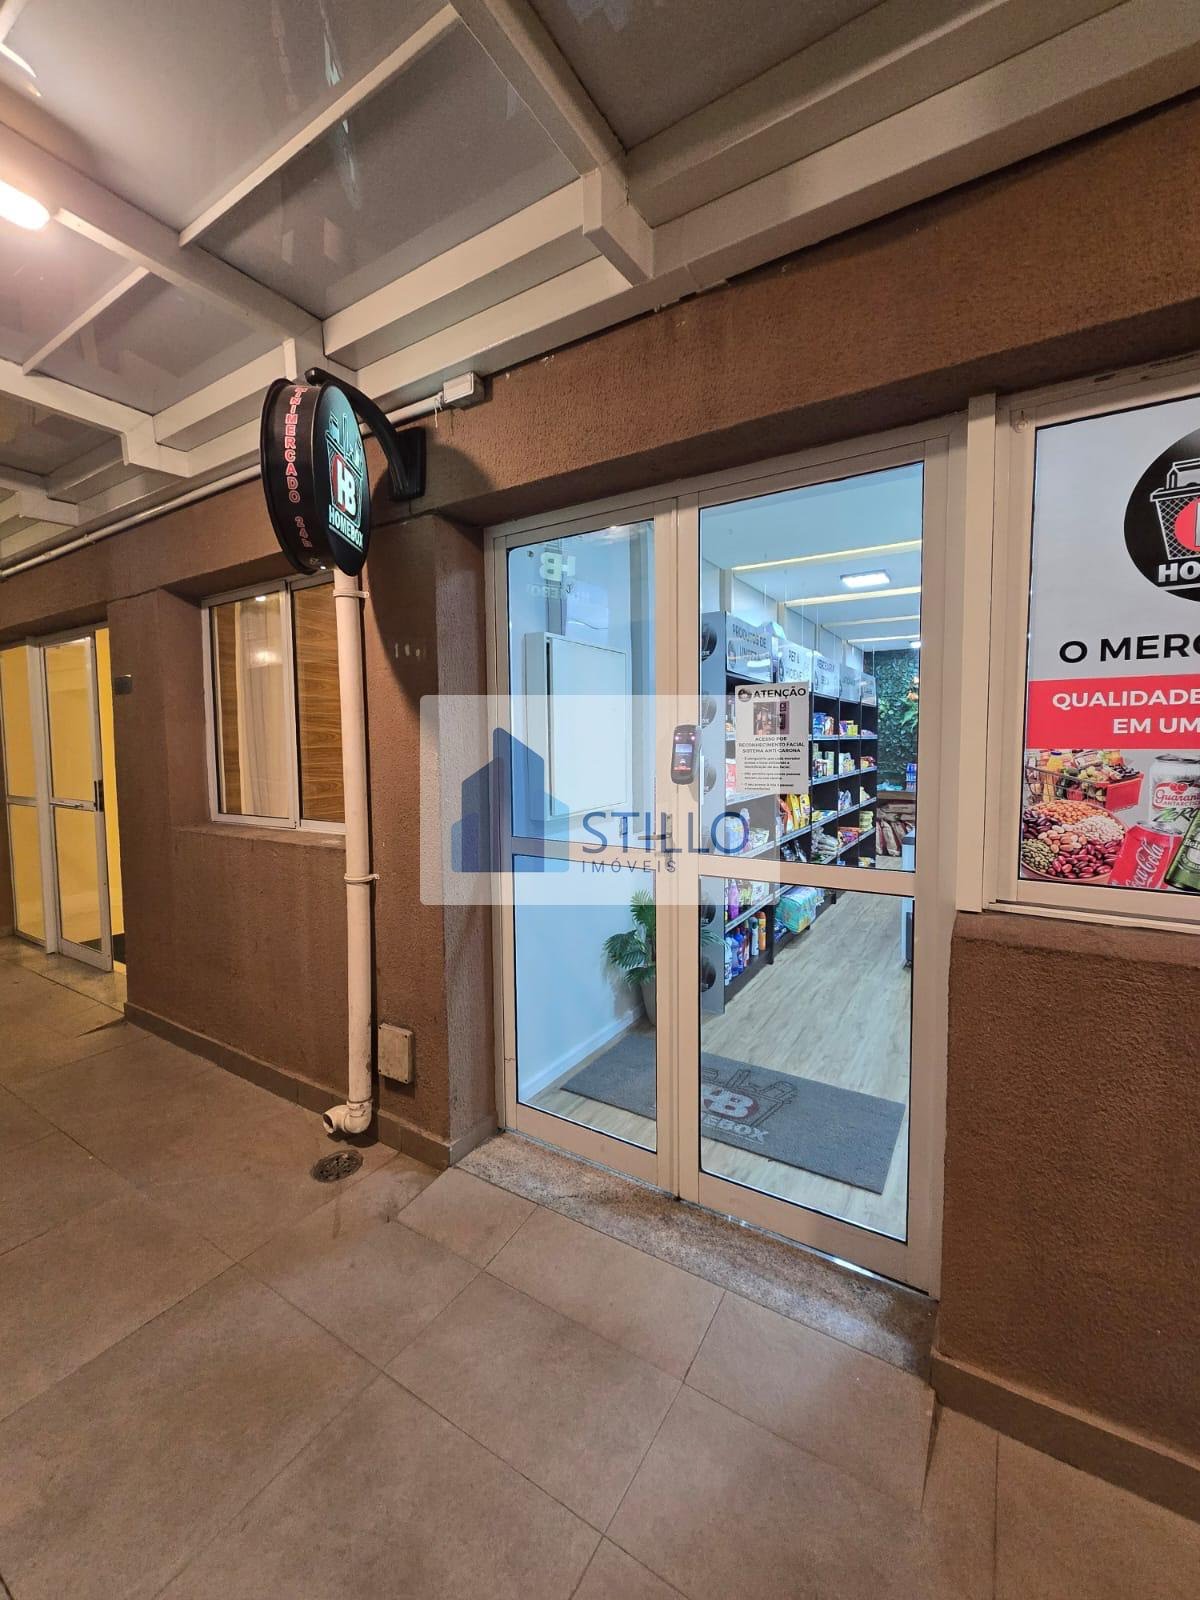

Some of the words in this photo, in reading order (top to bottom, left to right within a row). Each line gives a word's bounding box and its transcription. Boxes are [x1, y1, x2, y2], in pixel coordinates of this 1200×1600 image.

[328, 504, 364, 548] HOMEBOX
[1059, 641, 1088, 663] O
[752, 686, 807, 699] ATENÇÃO
[1113, 718, 1151, 734] EM
[1159, 717, 1200, 734] UM
